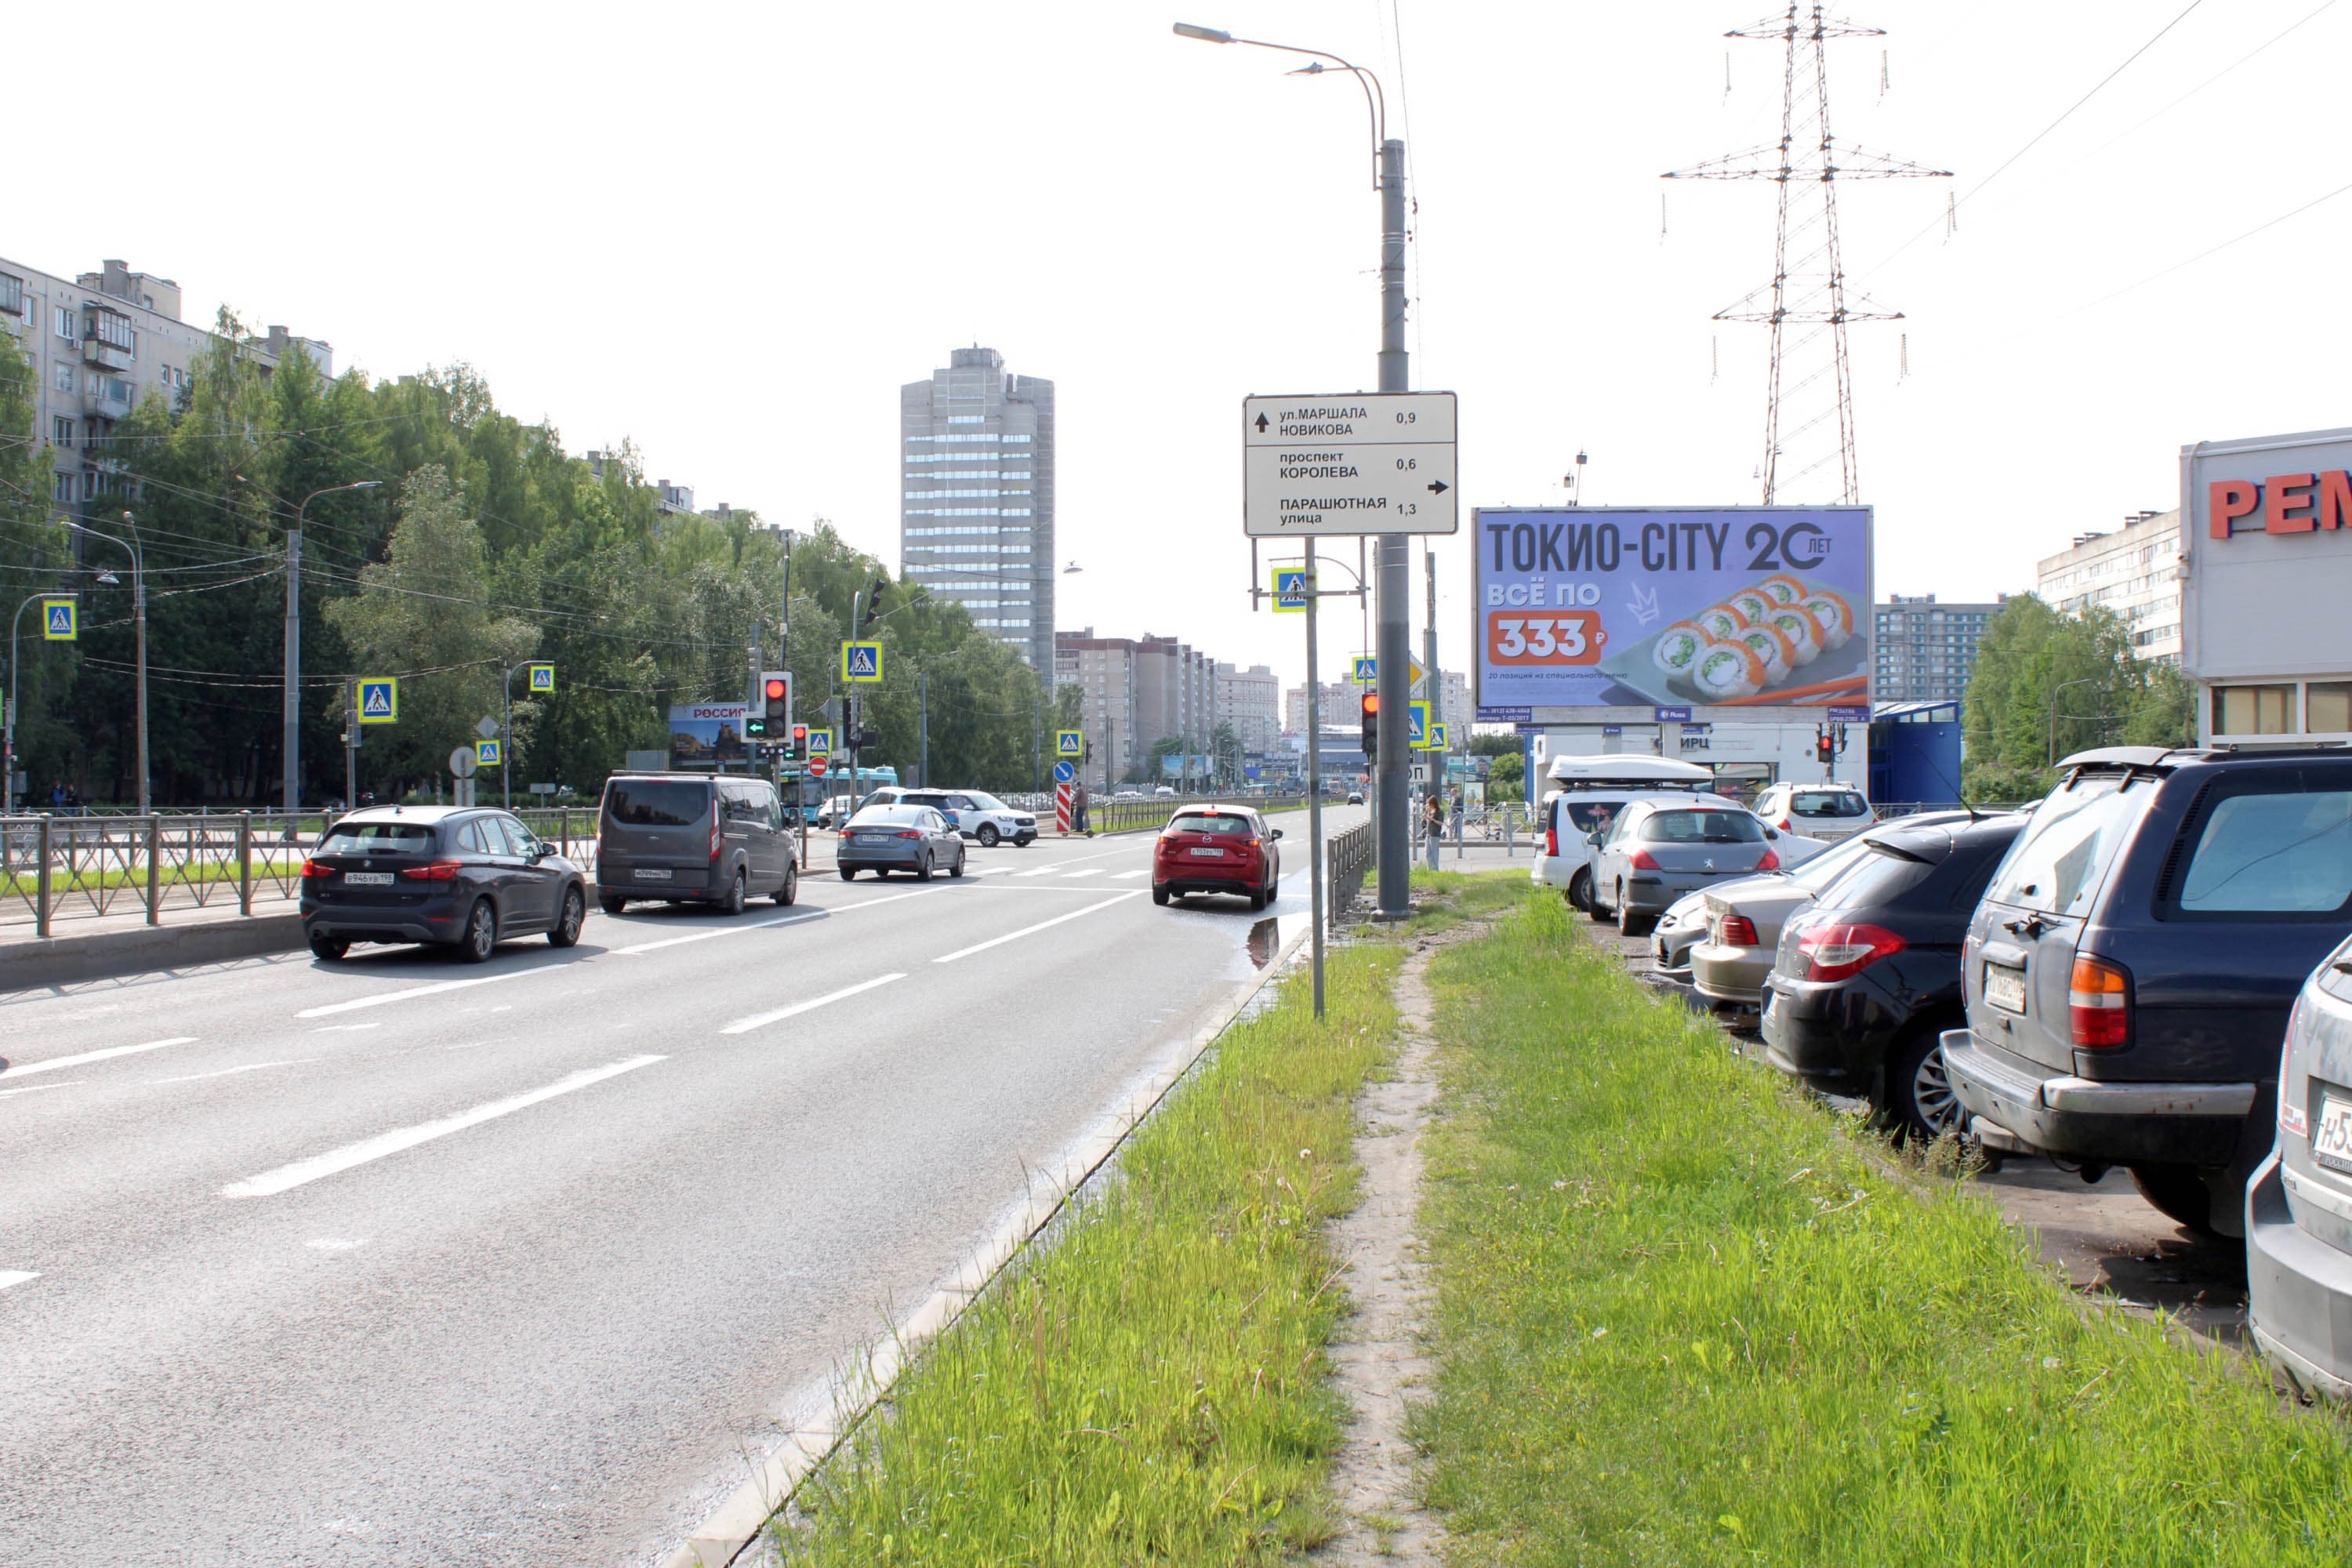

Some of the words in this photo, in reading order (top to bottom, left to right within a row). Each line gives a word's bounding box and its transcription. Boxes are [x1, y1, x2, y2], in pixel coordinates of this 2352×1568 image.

[1396, 412, 1416, 424] 0,9
[1279, 423, 1353, 436] НОВИКОВА
[1279, 452, 1344, 466] проспект
[1396, 459, 1416, 471] 0,6
[1279, 466, 1359, 479] КОРОЛЕВА
[1279, 498, 1387, 510] ПАРАШЮТНАЯ
[1397, 504, 1416, 516] 1,3
[1279, 514, 1322, 527] улица
[1486, 522, 1730, 572] ТОКИО-CITY
[1808, 538, 1831, 554] ЛЕТ
[1486, 576, 1546, 606] ВСЁ
[1555, 583, 1601, 606] ПО
[1497, 619, 1587, 657] 333
